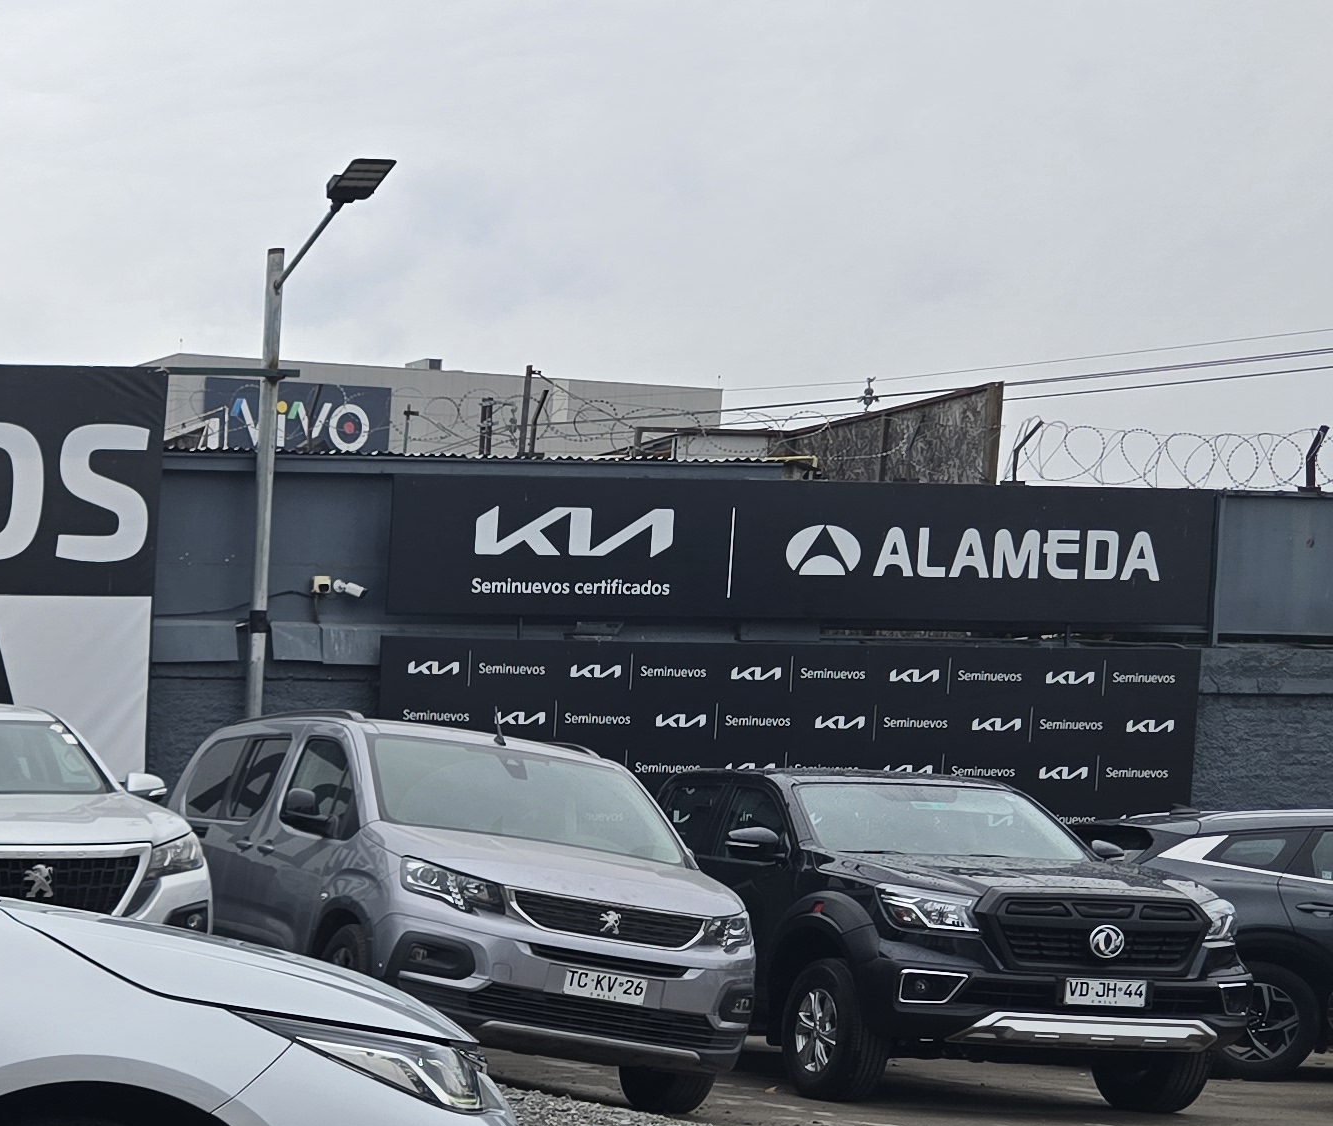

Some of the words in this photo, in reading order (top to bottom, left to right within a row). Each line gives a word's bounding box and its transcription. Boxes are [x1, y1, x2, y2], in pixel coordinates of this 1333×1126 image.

[873, 527, 1159, 581] ALAMEDA
[472, 578, 570, 594] Seminuevos
[575, 579, 670, 595] certificados
[479, 663, 545, 675] Seminuevos
[640, 666, 706, 677] Seminuevos
[800, 668, 865, 679] Seminuevos
[958, 670, 1022, 681] Seminuevos
[1113, 672, 1175, 683] Seminuevos
[403, 709, 469, 721] Seminuevos
[565, 713, 630, 724] Seminuevos
[725, 715, 790, 726] Seminuevos
[884, 717, 948, 728] Seminuevos
[1040, 719, 1103, 730] Seminuevos
[951, 765, 1015, 777] Seminuevos
[1106, 767, 1168, 778] Seminuevos
